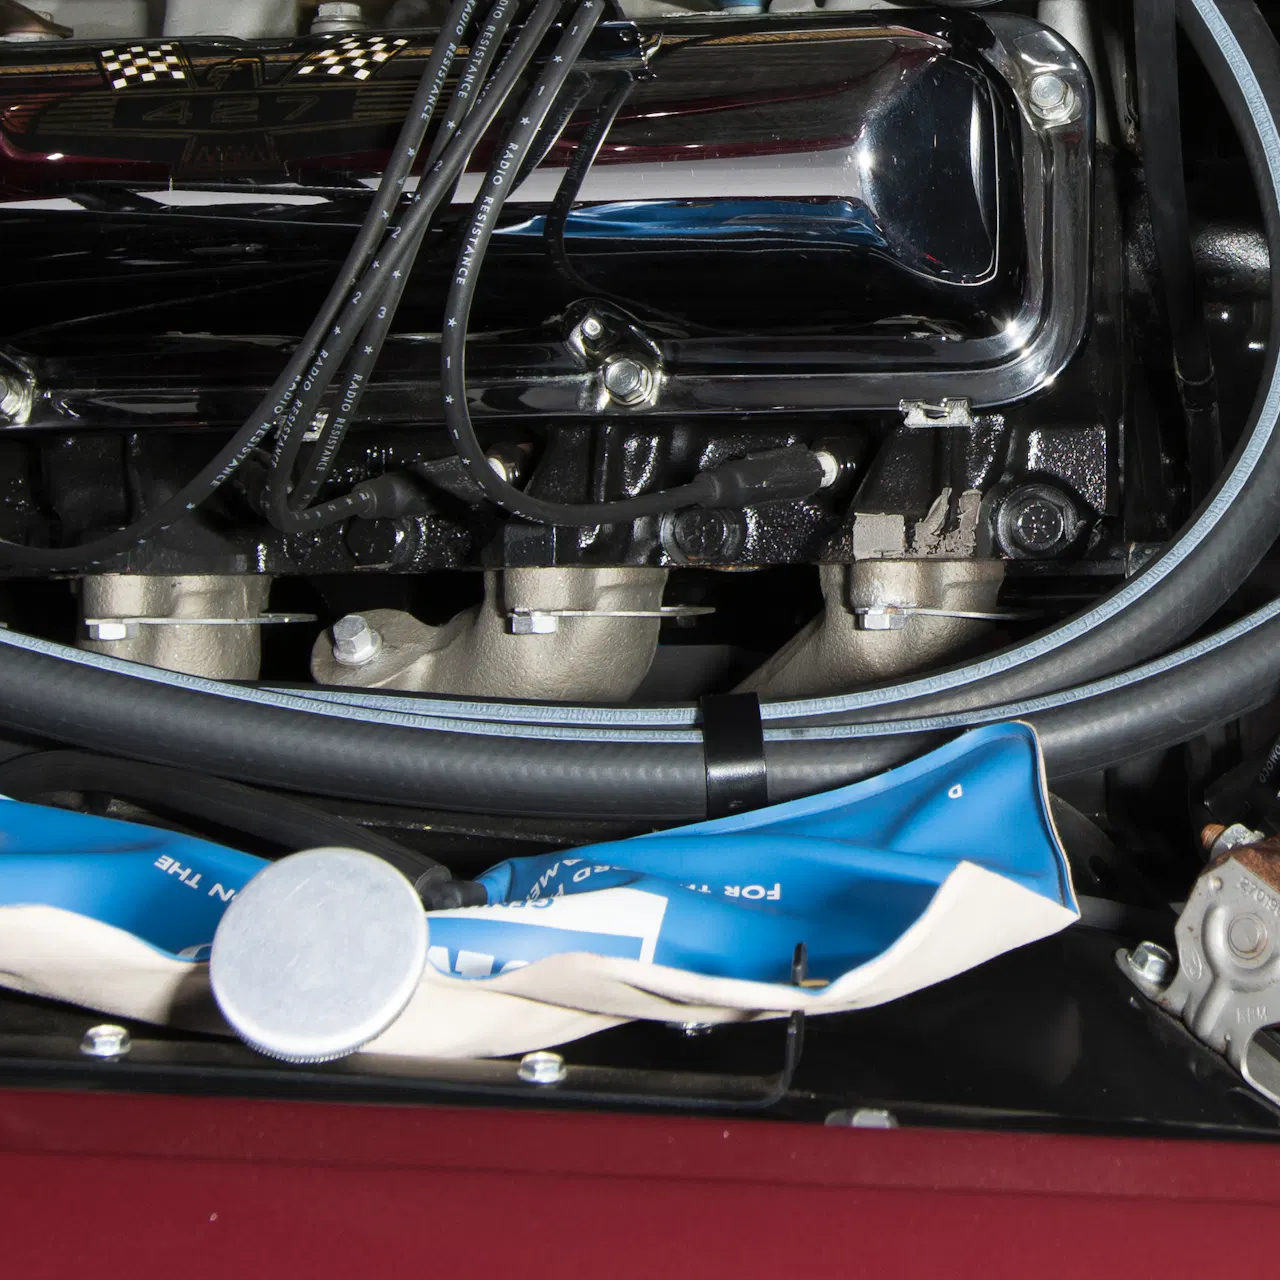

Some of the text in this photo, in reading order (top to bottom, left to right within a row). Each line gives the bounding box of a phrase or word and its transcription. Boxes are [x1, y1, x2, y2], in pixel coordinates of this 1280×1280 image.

[420, 42, 457, 121] RESISTANCE
[457, 24, 497, 99] RESISTANCE
[142, 94, 323, 126] 427
[492, 142, 520, 187] RADIO
[391, 226, 402, 239] 2
[455, 195, 496, 286] RESISTANCE
[351, 291, 363, 305] 2
[303, 349, 330, 392] RADIO
[316, 306, 388, 472] 3 RADIO RESISTANCE
[210, 421, 272, 488] RESISTANCE
[272, 398, 305, 469] RESISTANCE
[153, 854, 237, 903] THE N
[723, 882, 781, 901] FOR
